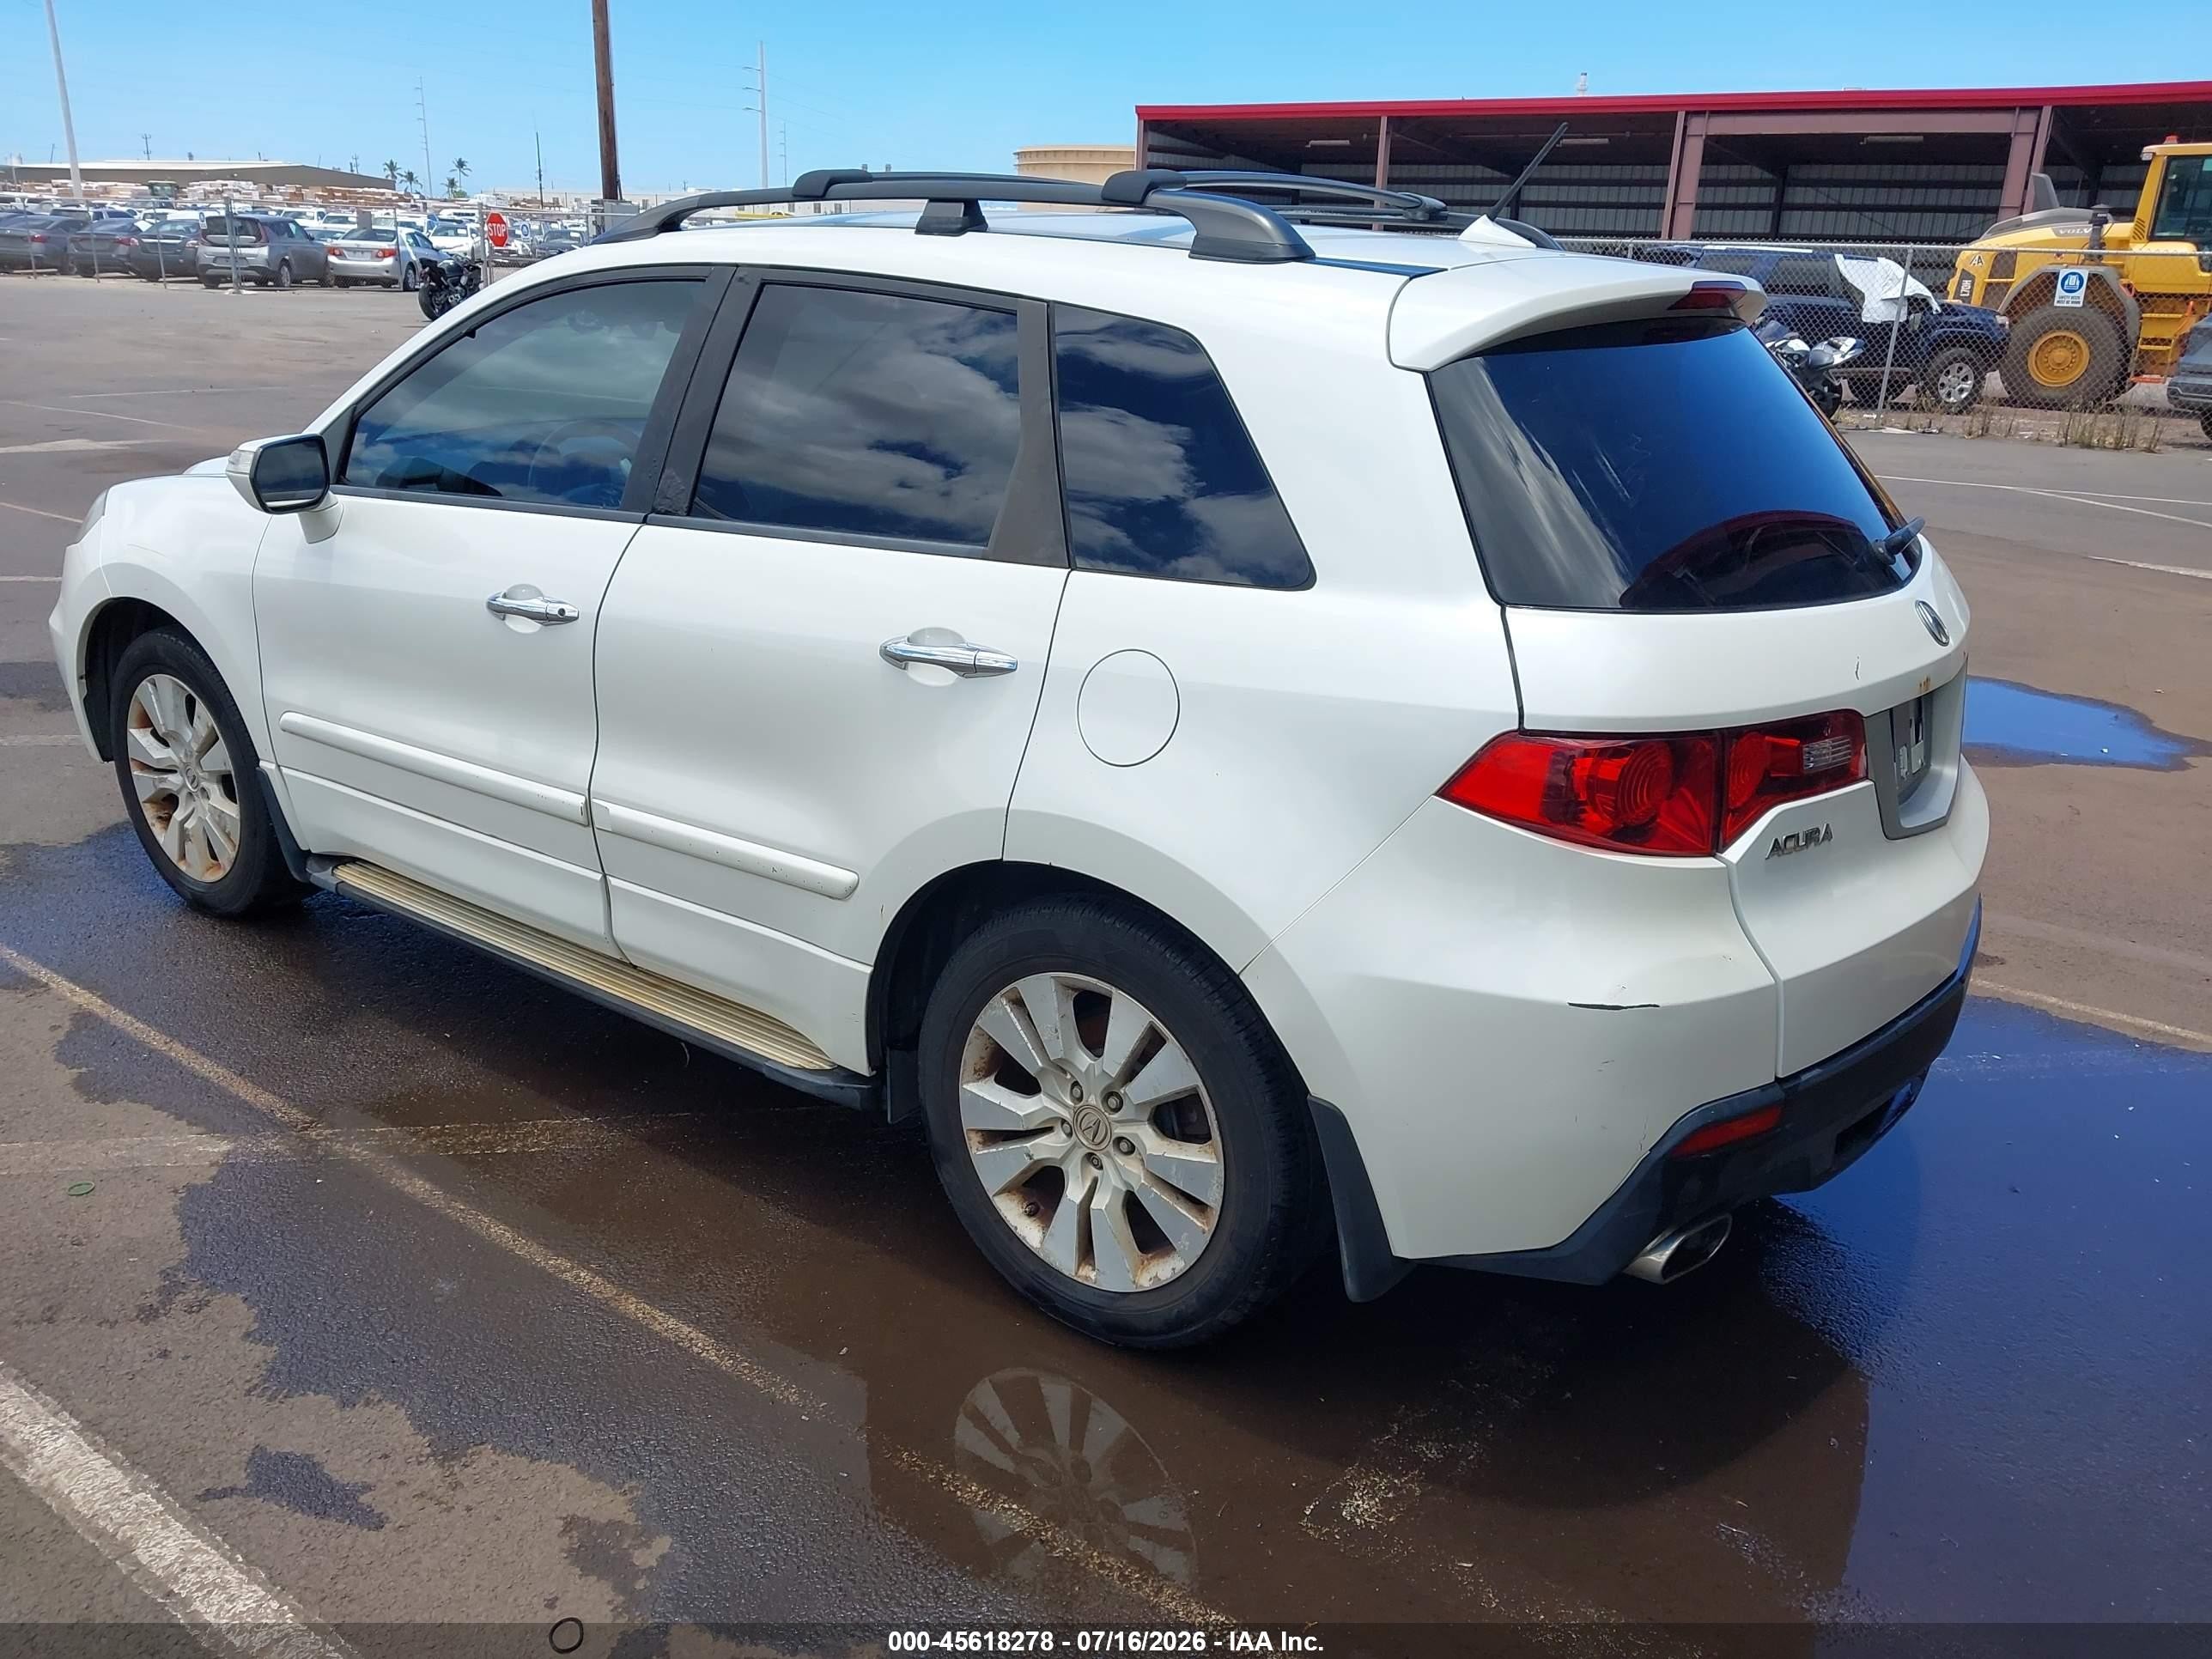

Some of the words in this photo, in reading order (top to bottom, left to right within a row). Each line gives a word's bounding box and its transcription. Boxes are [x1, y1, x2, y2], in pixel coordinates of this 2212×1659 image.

[488, 223, 506, 237] STOP
[1960, 279, 1972, 297] L70H
[1765, 823, 1833, 860] ACURA
